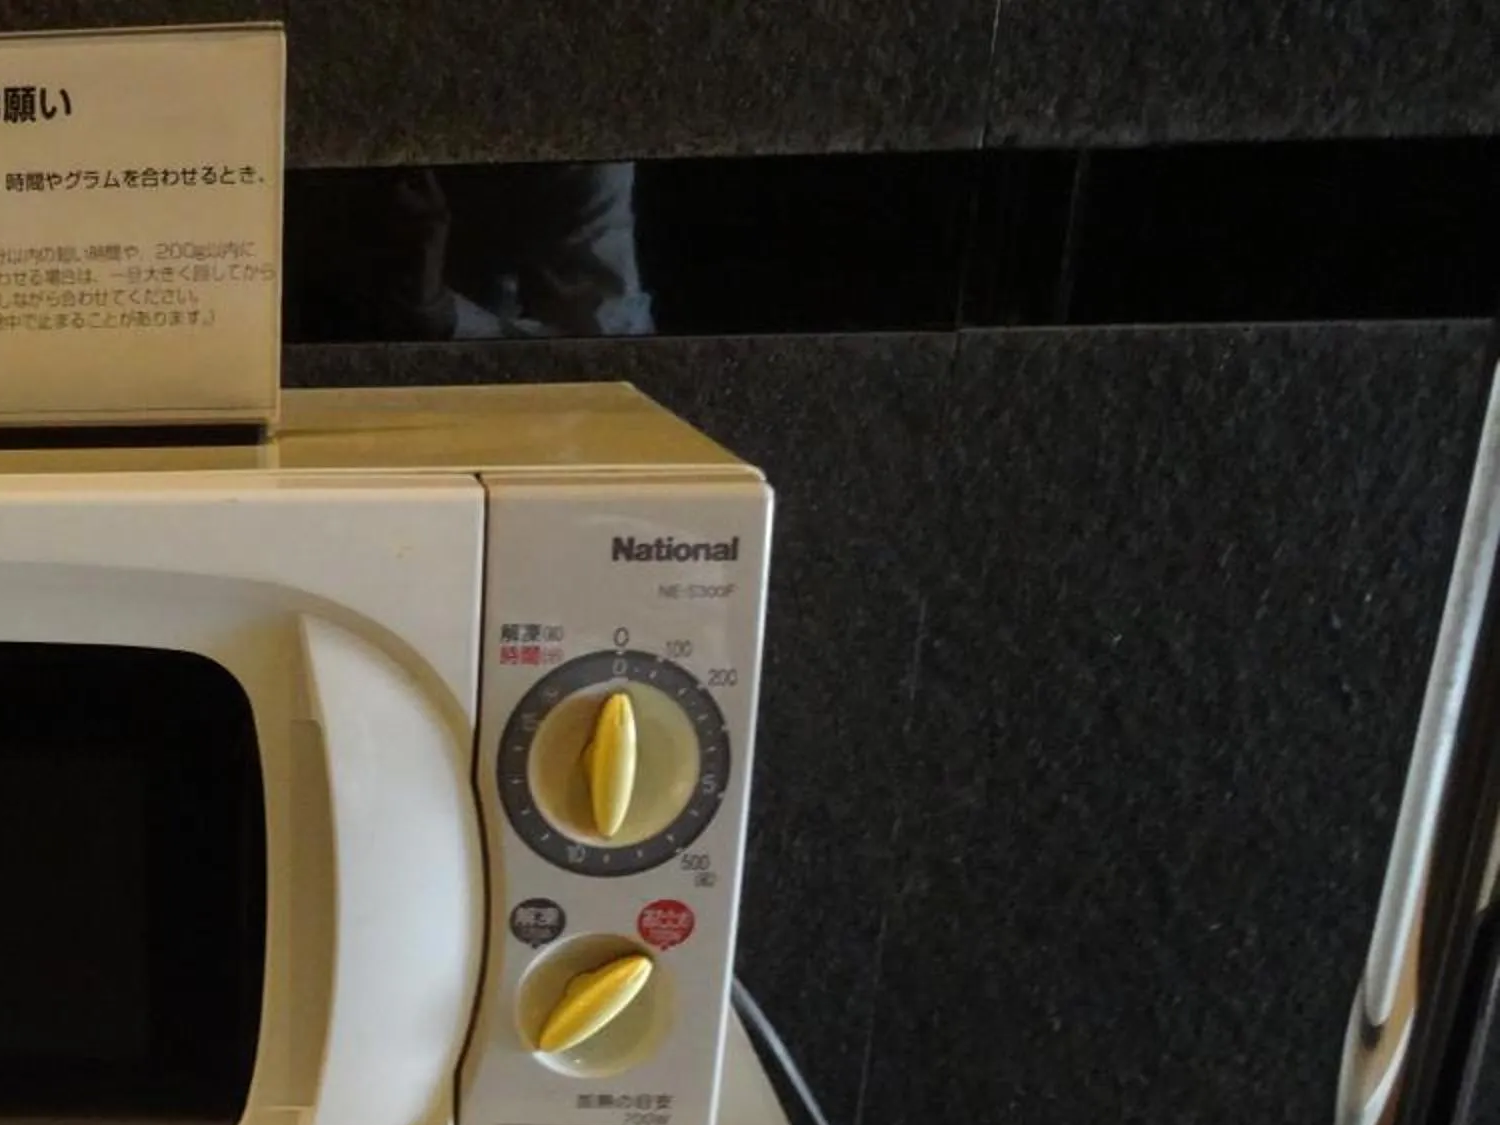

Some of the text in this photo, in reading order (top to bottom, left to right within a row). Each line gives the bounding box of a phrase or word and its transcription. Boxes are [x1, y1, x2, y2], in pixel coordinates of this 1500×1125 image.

[611, 536, 739, 563] National
[613, 627, 630, 647] 0
[665, 640, 694, 660] 100
[612, 659, 629, 676] 0
[707, 668, 738, 688] 200
[680, 853, 711, 871] 500
